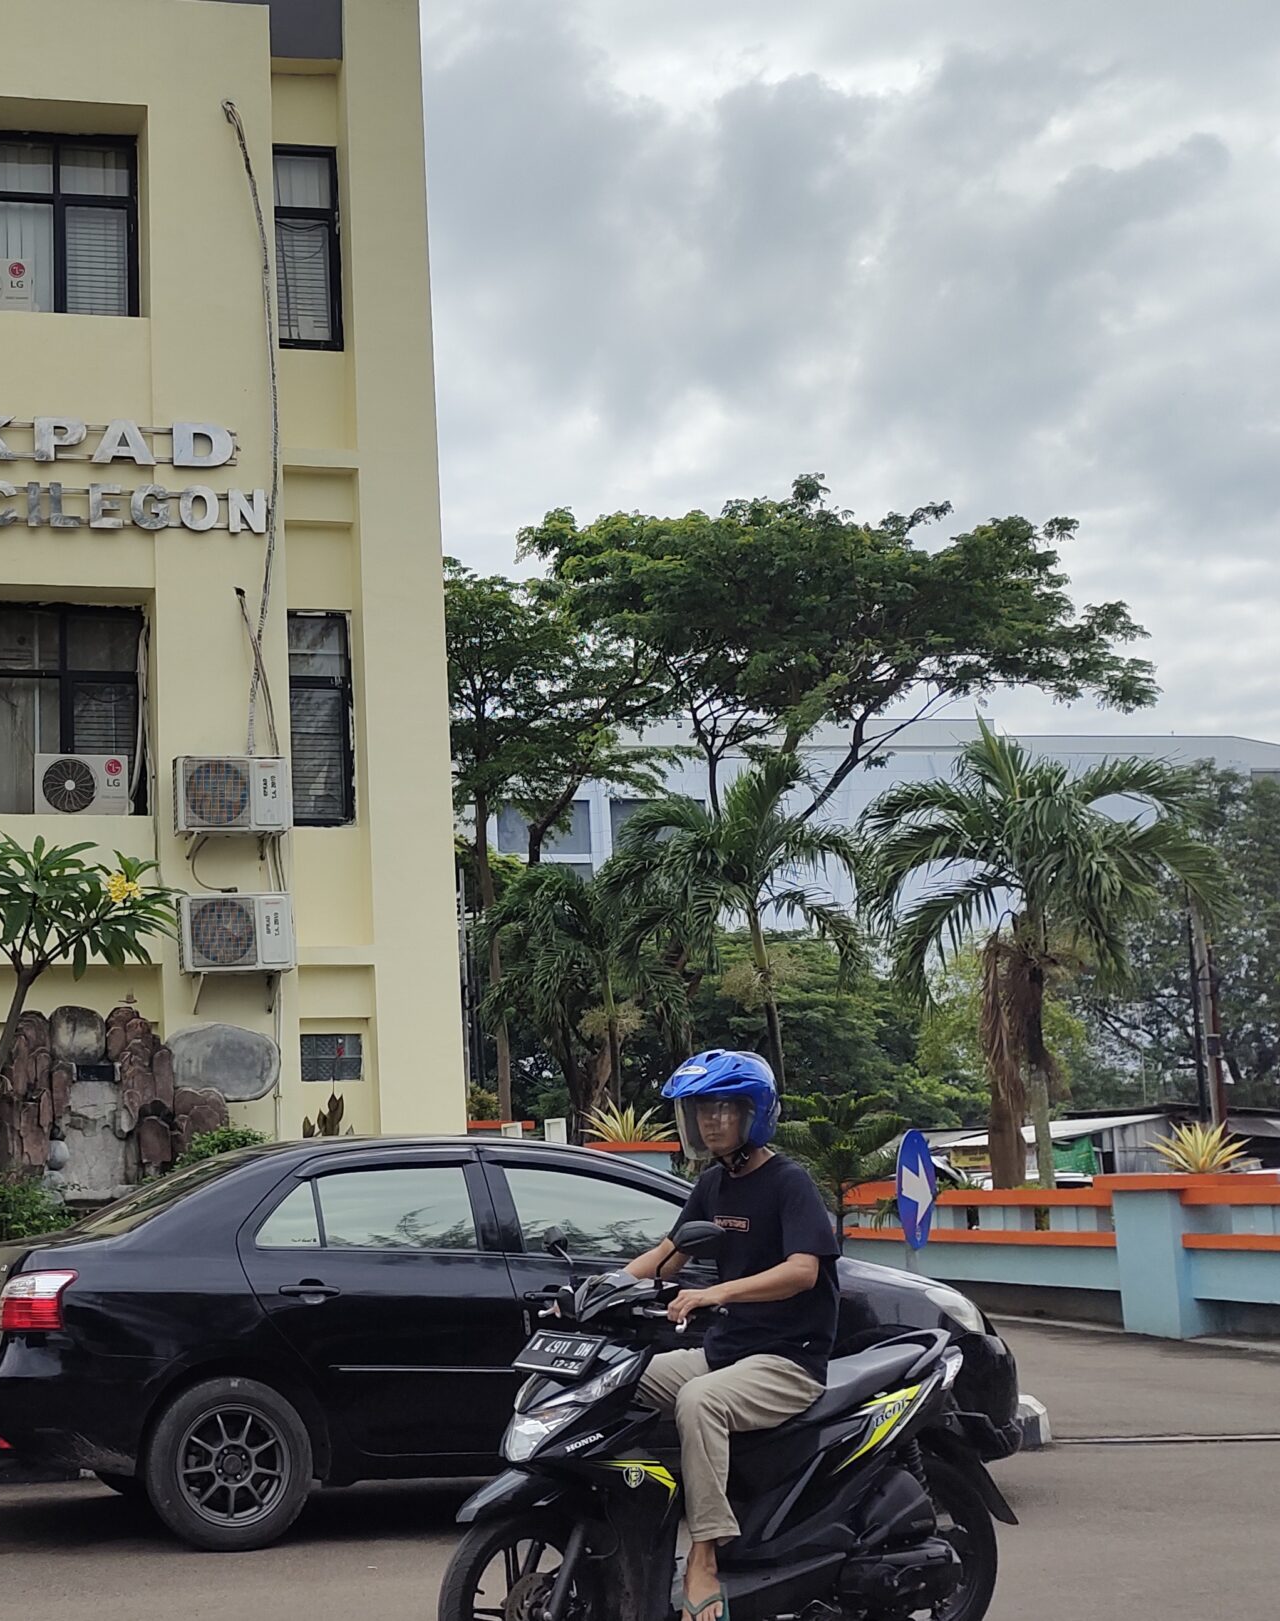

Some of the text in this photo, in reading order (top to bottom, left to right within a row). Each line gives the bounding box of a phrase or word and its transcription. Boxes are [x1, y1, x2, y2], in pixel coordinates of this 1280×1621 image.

[10, 280, 24, 289] LG
[106, 778, 121, 788] LG
[531, 1337, 545, 1351] A
[564, 1432, 605, 1453] HONDA
